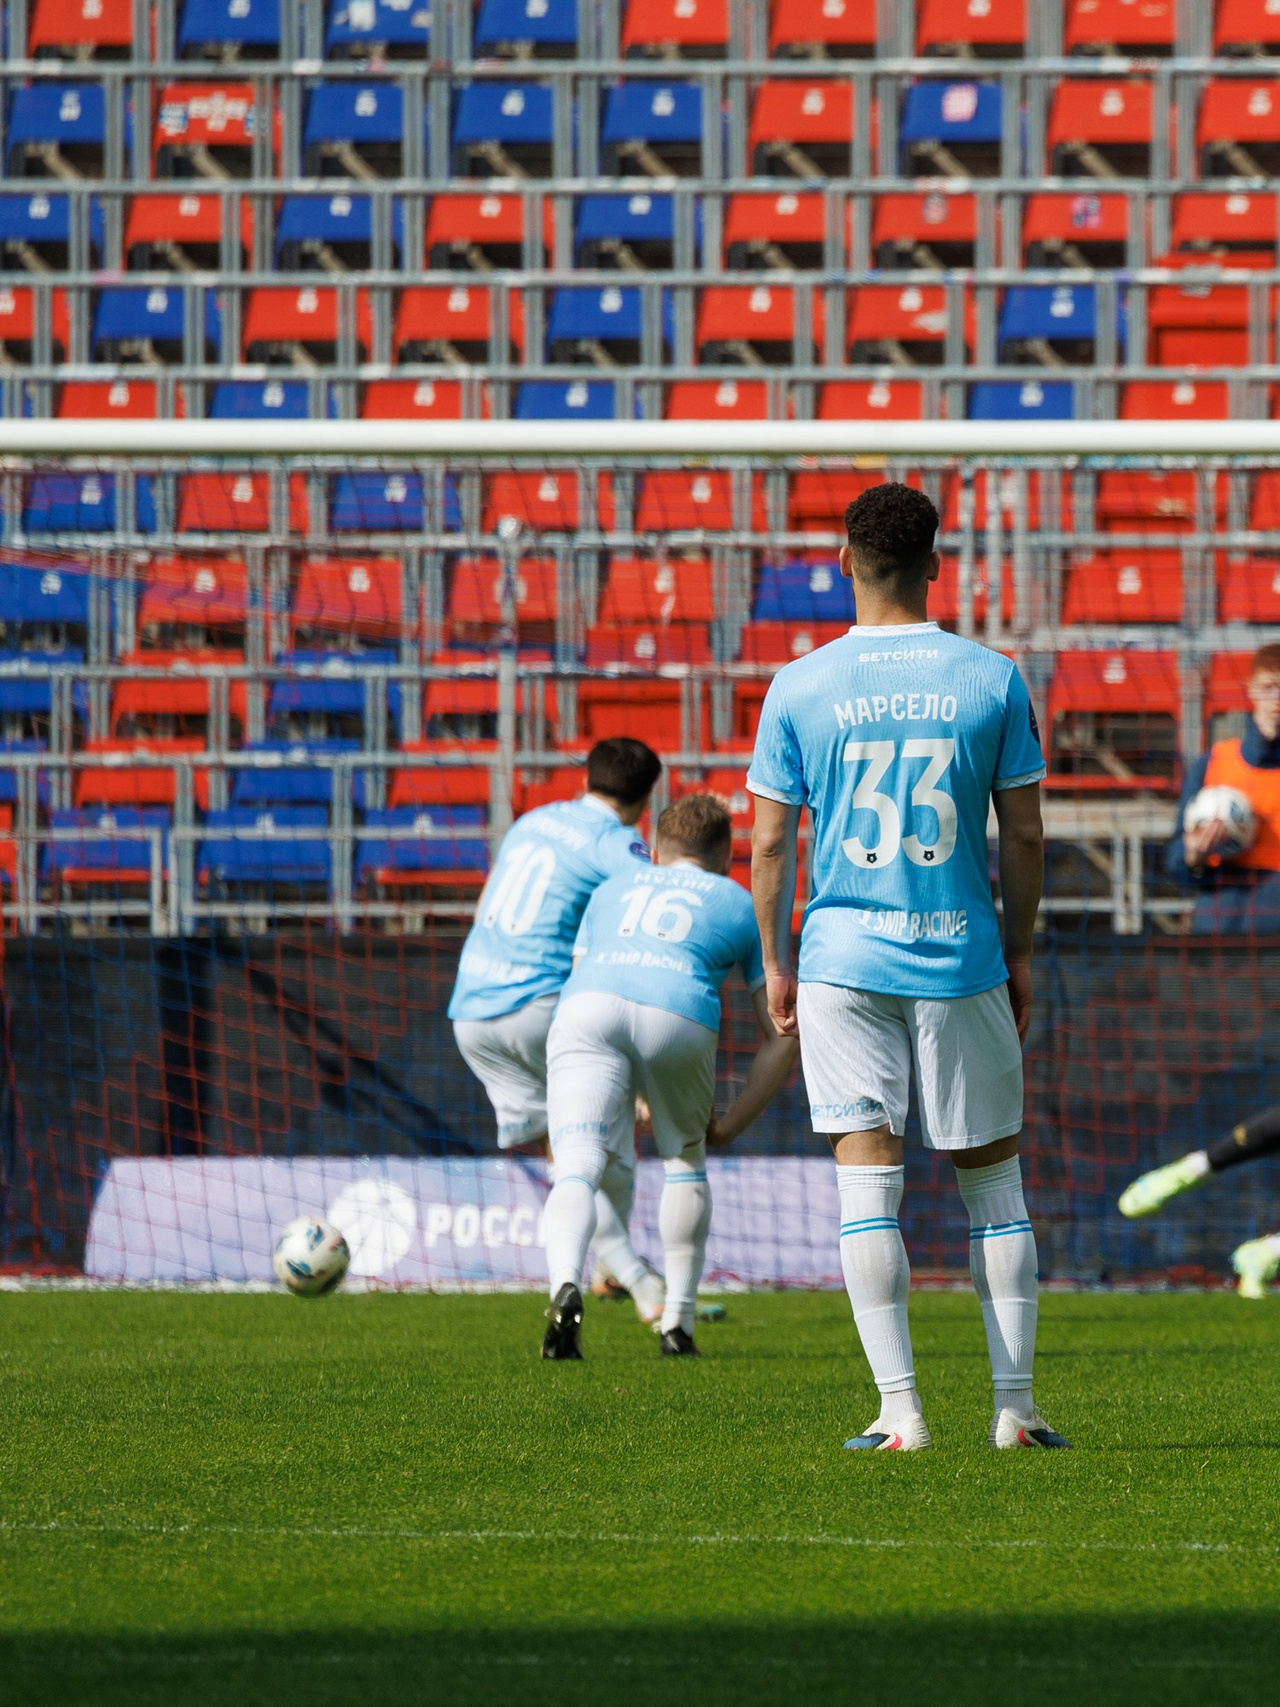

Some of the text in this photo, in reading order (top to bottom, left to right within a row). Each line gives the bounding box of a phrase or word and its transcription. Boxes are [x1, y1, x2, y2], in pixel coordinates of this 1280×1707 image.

[858, 649, 938, 662] БЕТСИТИ
[834, 693, 957, 729] МАРСЕЛО
[842, 738, 958, 869] 33
[482, 840, 556, 937] 10
[618, 885, 703, 942] 16
[872, 908, 968, 939] SMP RACING
